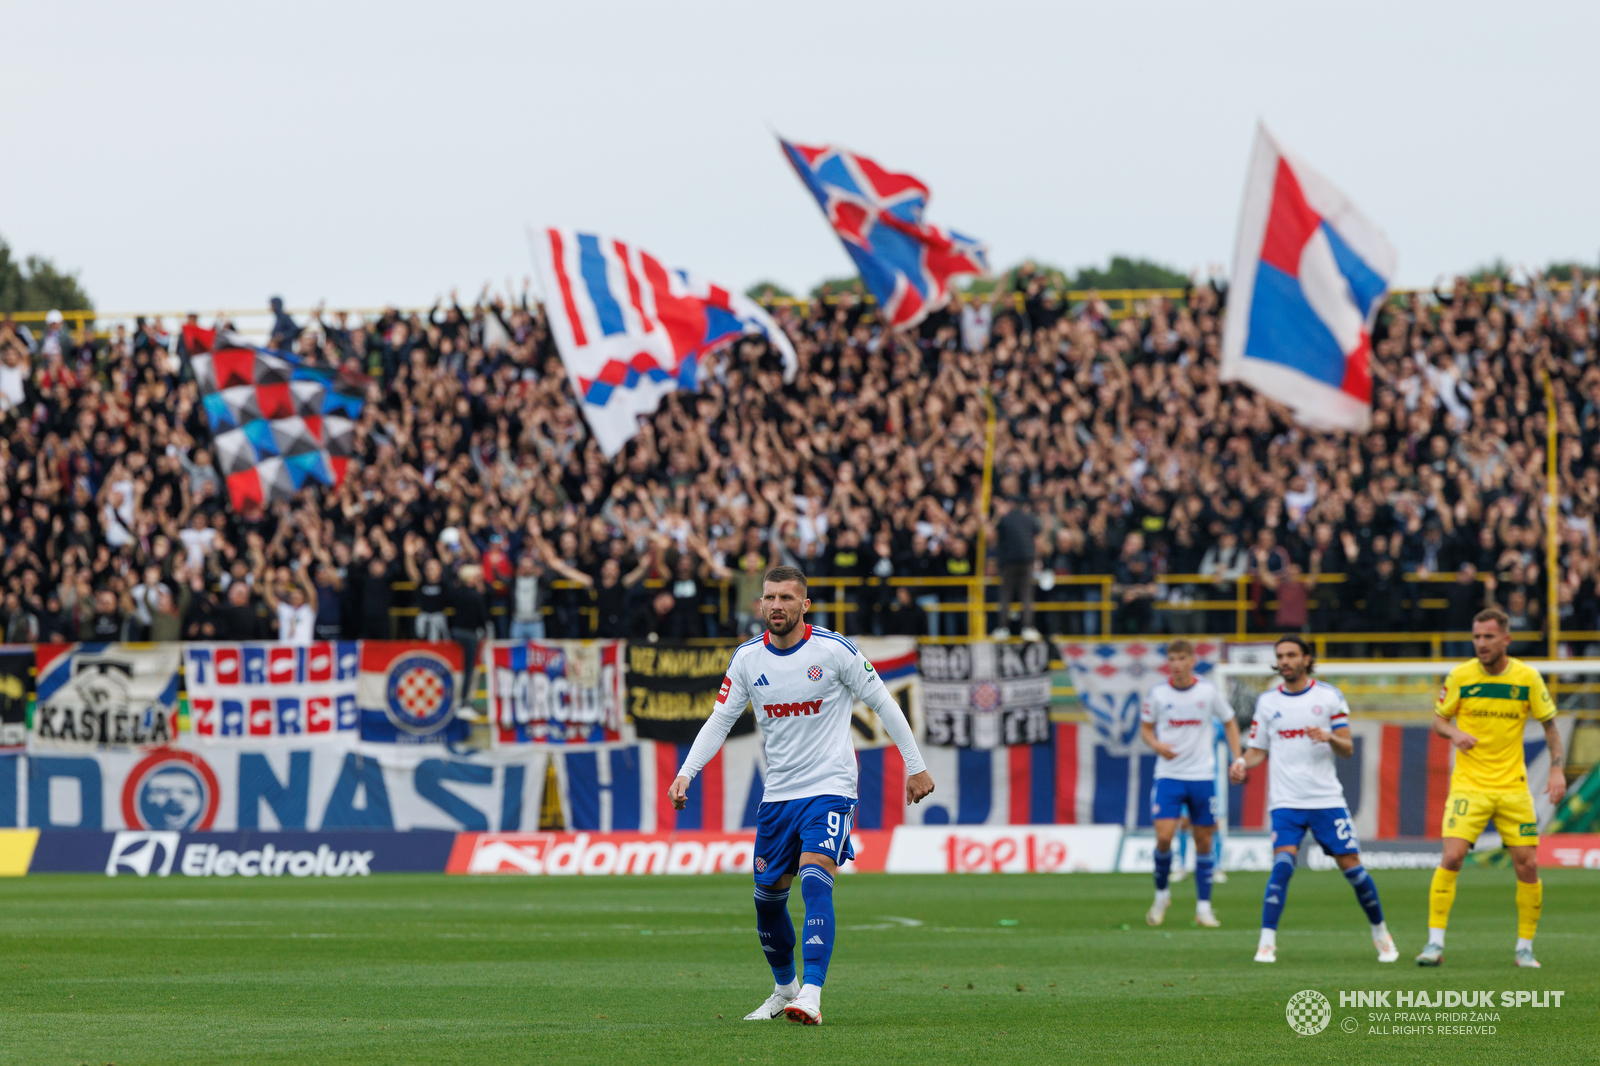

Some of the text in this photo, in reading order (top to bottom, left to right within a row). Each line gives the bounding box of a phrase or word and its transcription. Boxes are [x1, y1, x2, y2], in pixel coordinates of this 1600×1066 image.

[193, 695, 358, 737] ZAGREB
[763, 699, 824, 718] TOMMY
[826, 811, 841, 837] 9
[181, 842, 375, 877] Electrolux
[548, 831, 757, 877] dompro
[807, 918, 824, 926] 1911
